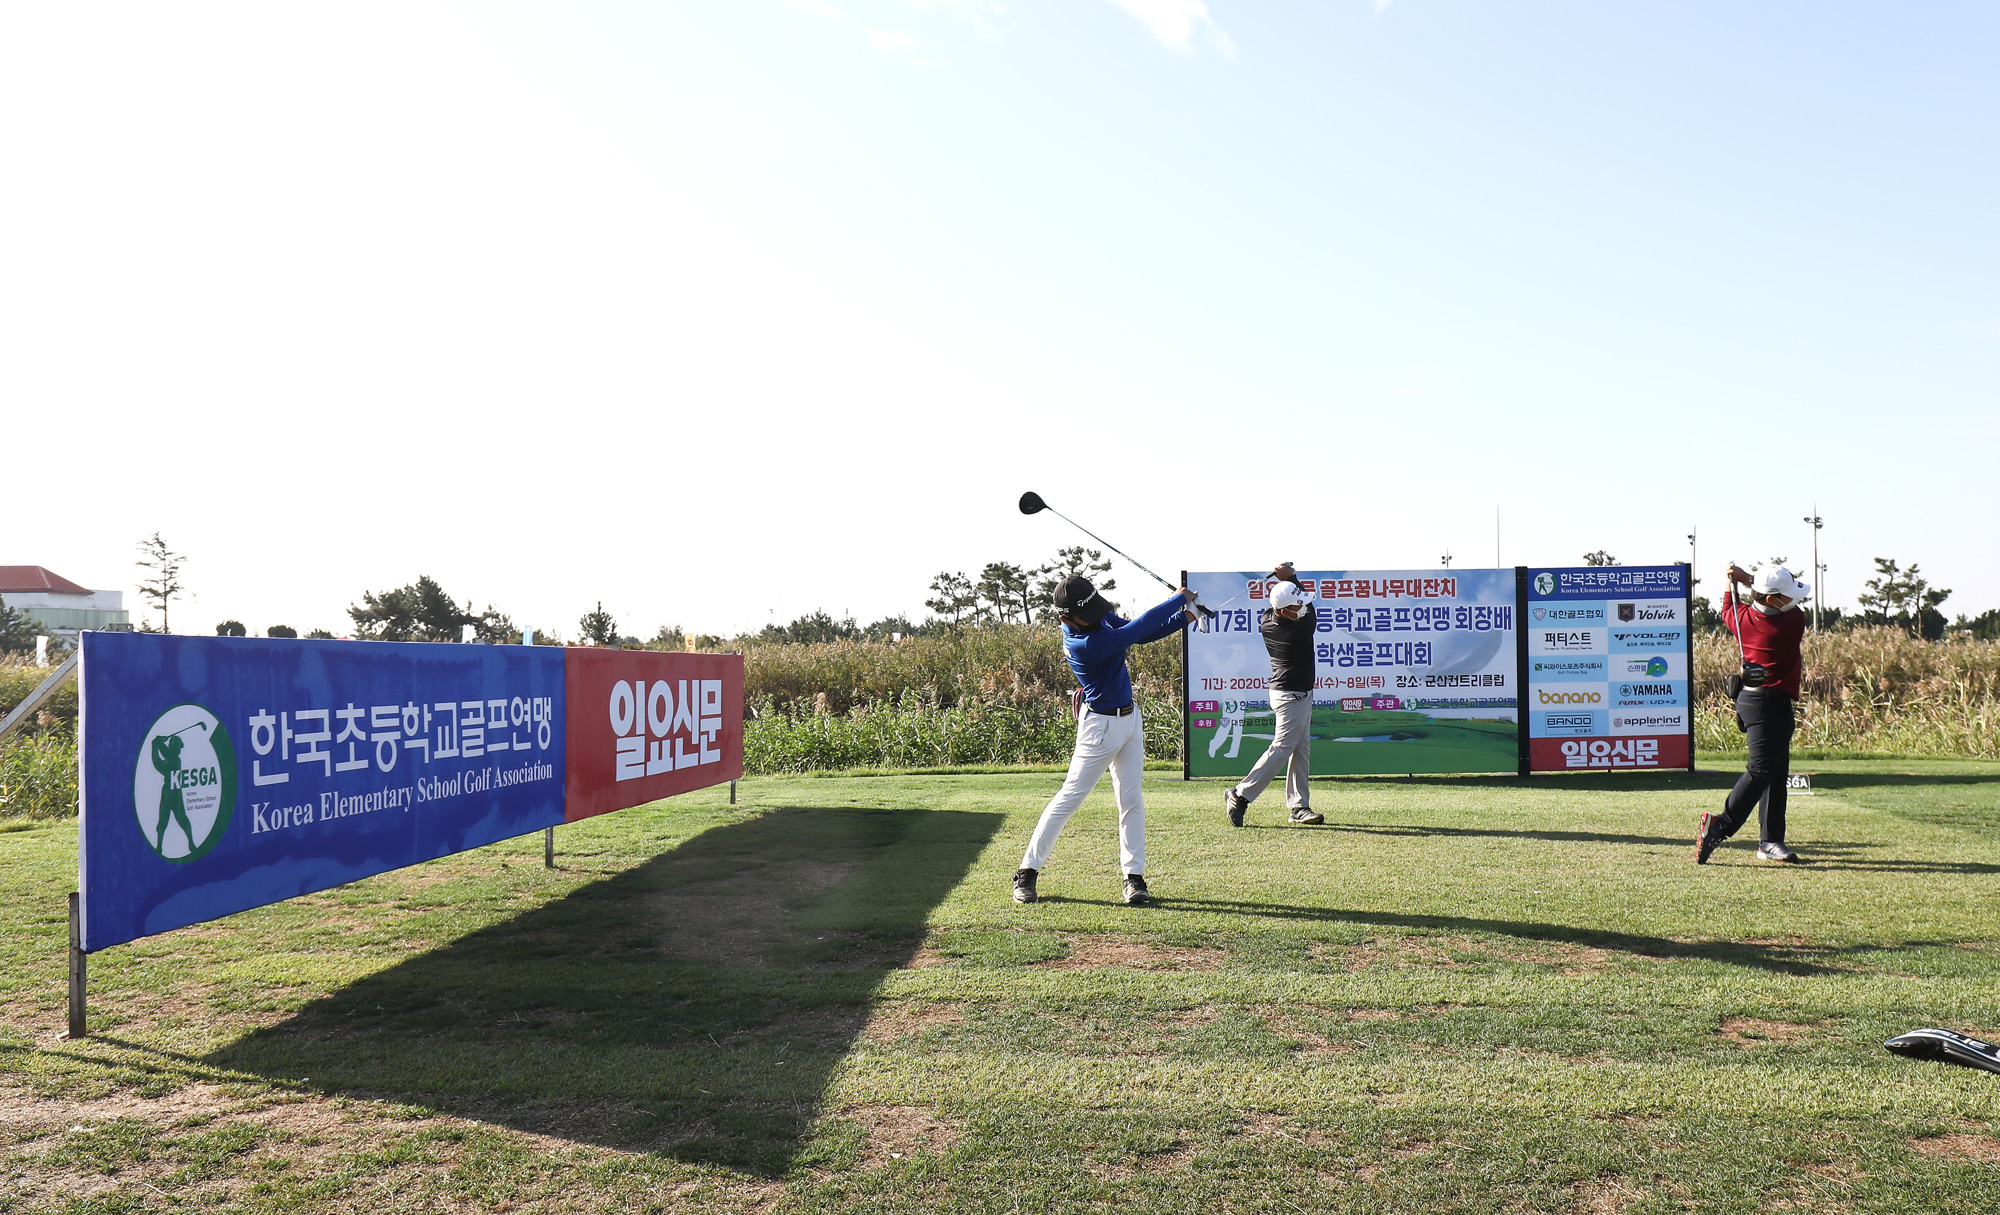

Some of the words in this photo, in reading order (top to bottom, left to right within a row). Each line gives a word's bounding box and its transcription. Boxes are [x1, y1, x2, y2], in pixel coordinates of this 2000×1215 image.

[1560, 571, 1680, 586] 한국초등학교골프연맹
[1320, 578, 1456, 599] 골프꿈나무대잔치
[1257, 606, 1451, 634] 등학교골프연맹
[1455, 606, 1512, 631] 회장배
[1549, 609, 1604, 620] 대한골프협회
[1637, 609, 1676, 620] Volvik
[1545, 632, 1592, 647] 퍼티스트
[1201, 677, 1227, 691] 기간:
[1396, 675, 1422, 688] 장소:
[1425, 674, 1505, 688] 군산컨트리클럽
[1633, 684, 1672, 696] YAMAHA
[1538, 690, 1601, 704] banano
[1195, 701, 1214, 712] 주최
[1376, 699, 1395, 709] 주관
[1547, 717, 1592, 726] BANDO
[1624, 715, 1680, 727] applerind
[609, 679, 722, 782] 일요신문
[249, 696, 552, 787] 한국초등학교골프연맹
[1561, 739, 1658, 767] 일요신문
[170, 766, 218, 790] KESGA
[251, 802, 314, 834] Korea
[319, 786, 413, 821] Elementary
[417, 771, 461, 803] School
[464, 766, 492, 795] Golf
[493, 760, 552, 788] Association
